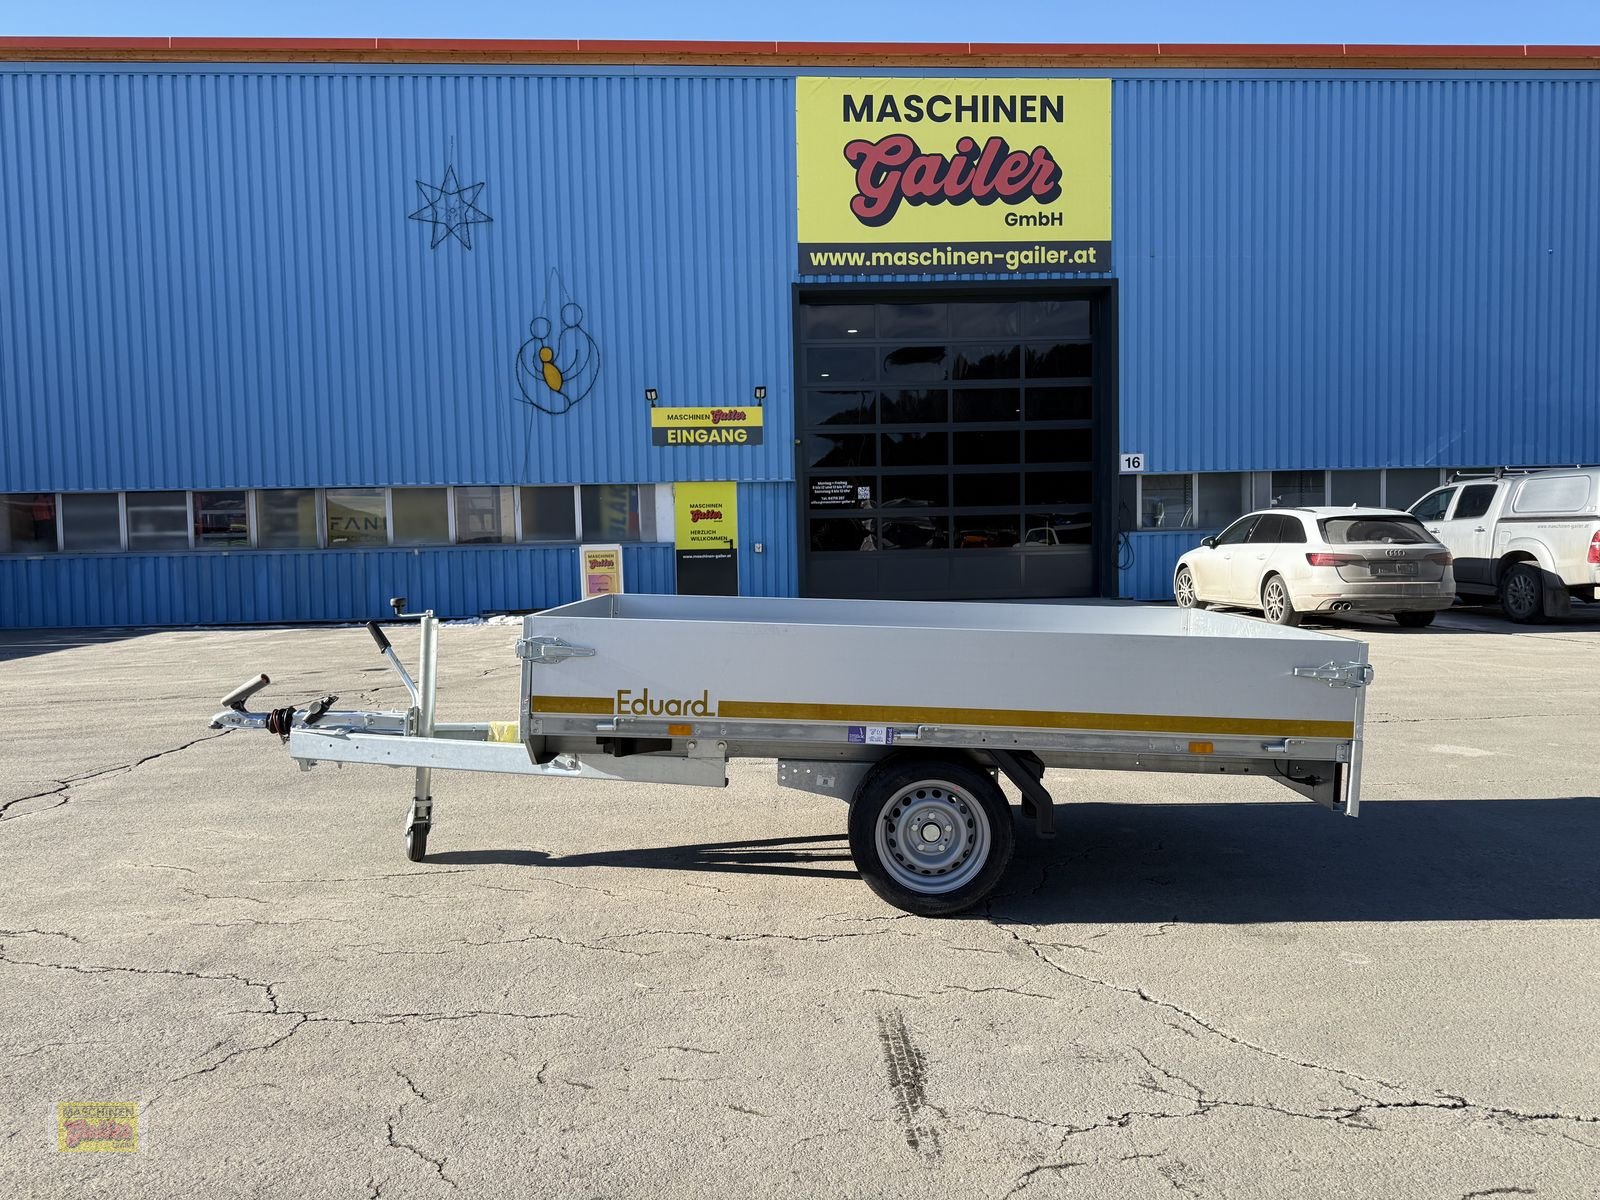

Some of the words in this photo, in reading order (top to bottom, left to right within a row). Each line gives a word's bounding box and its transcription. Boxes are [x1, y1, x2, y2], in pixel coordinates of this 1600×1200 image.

[843, 94, 1064, 123] MASCHINEN
[843, 133, 1063, 227] Gailer
[1004, 211, 1063, 226] GmbH
[810, 246, 1097, 270] www.maschinen-gailer.at
[710, 409, 746, 424] Gailer
[667, 429, 747, 443] EINGANG
[1125, 456, 1141, 469] 16
[617, 688, 715, 716] Eduard
